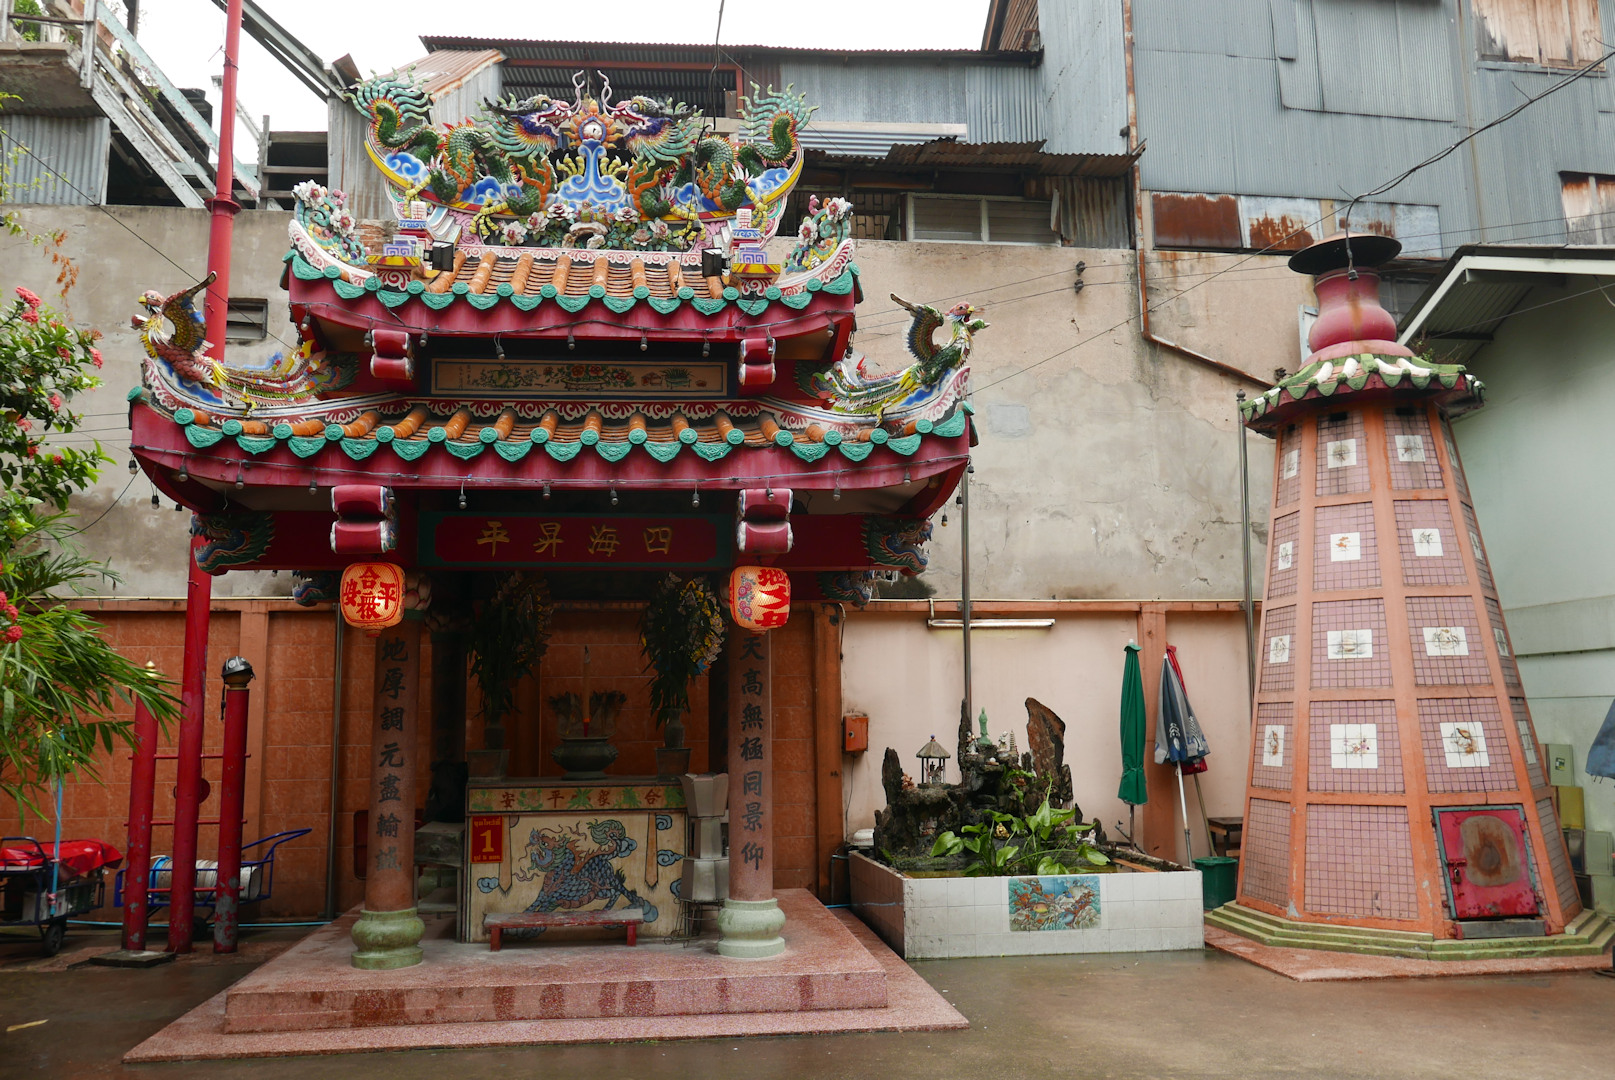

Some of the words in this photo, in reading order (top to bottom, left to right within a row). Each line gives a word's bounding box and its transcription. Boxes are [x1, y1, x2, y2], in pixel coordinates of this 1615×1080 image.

[476, 520, 673, 558] 四海昇平
[479, 829, 495, 853] 1
